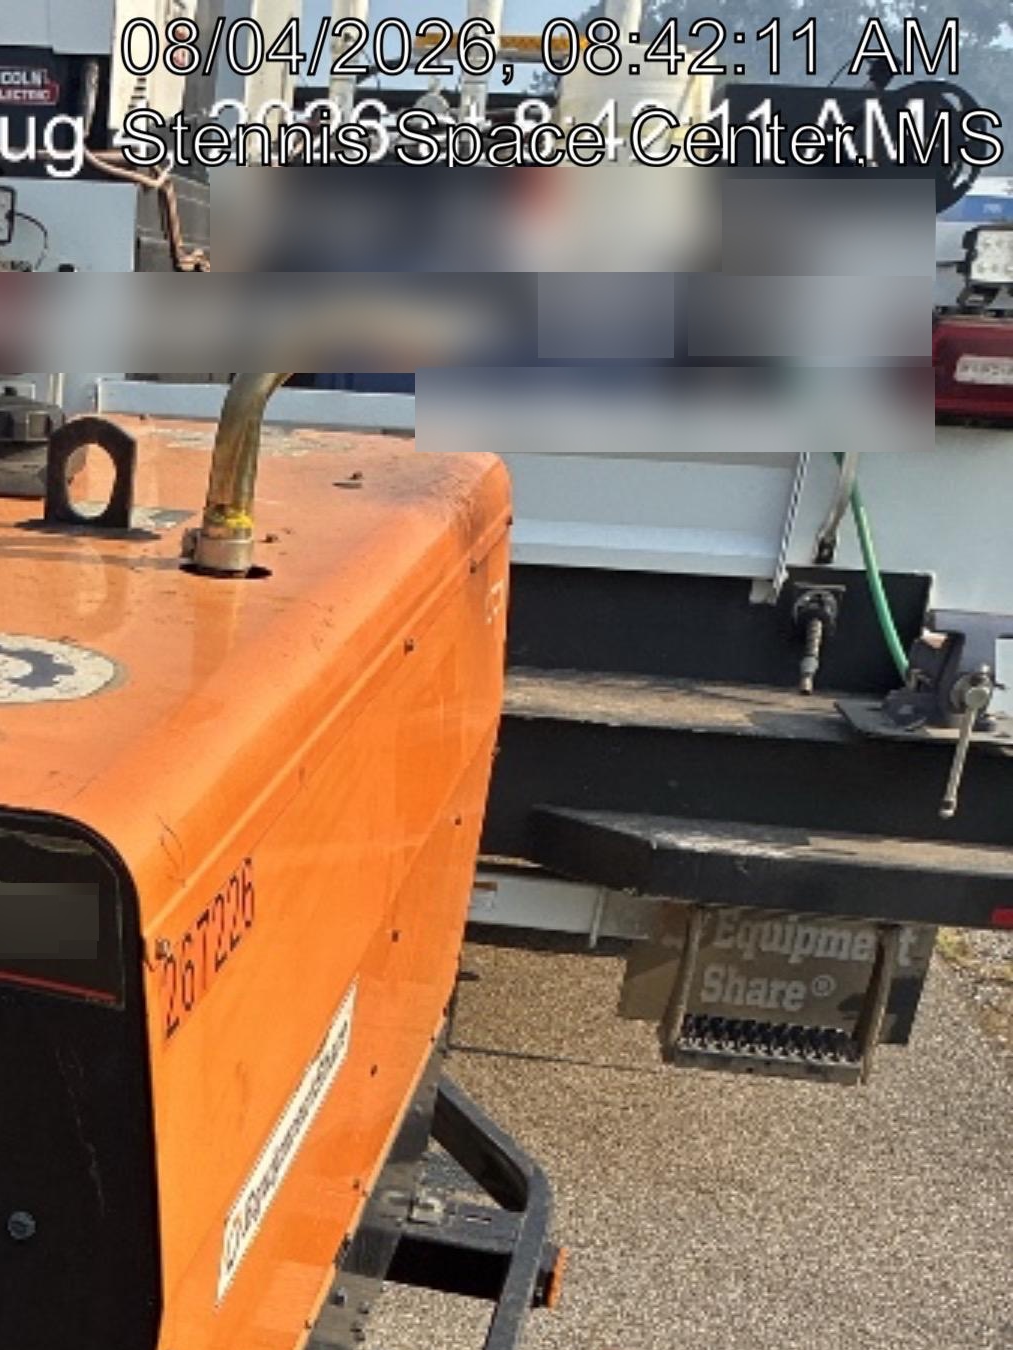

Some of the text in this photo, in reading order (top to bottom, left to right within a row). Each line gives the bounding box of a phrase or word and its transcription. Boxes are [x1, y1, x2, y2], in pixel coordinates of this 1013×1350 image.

[162, 857, 255, 1039] 267226
[713, 909, 917, 967] Equipmet
[700, 962, 807, 1012] Share
